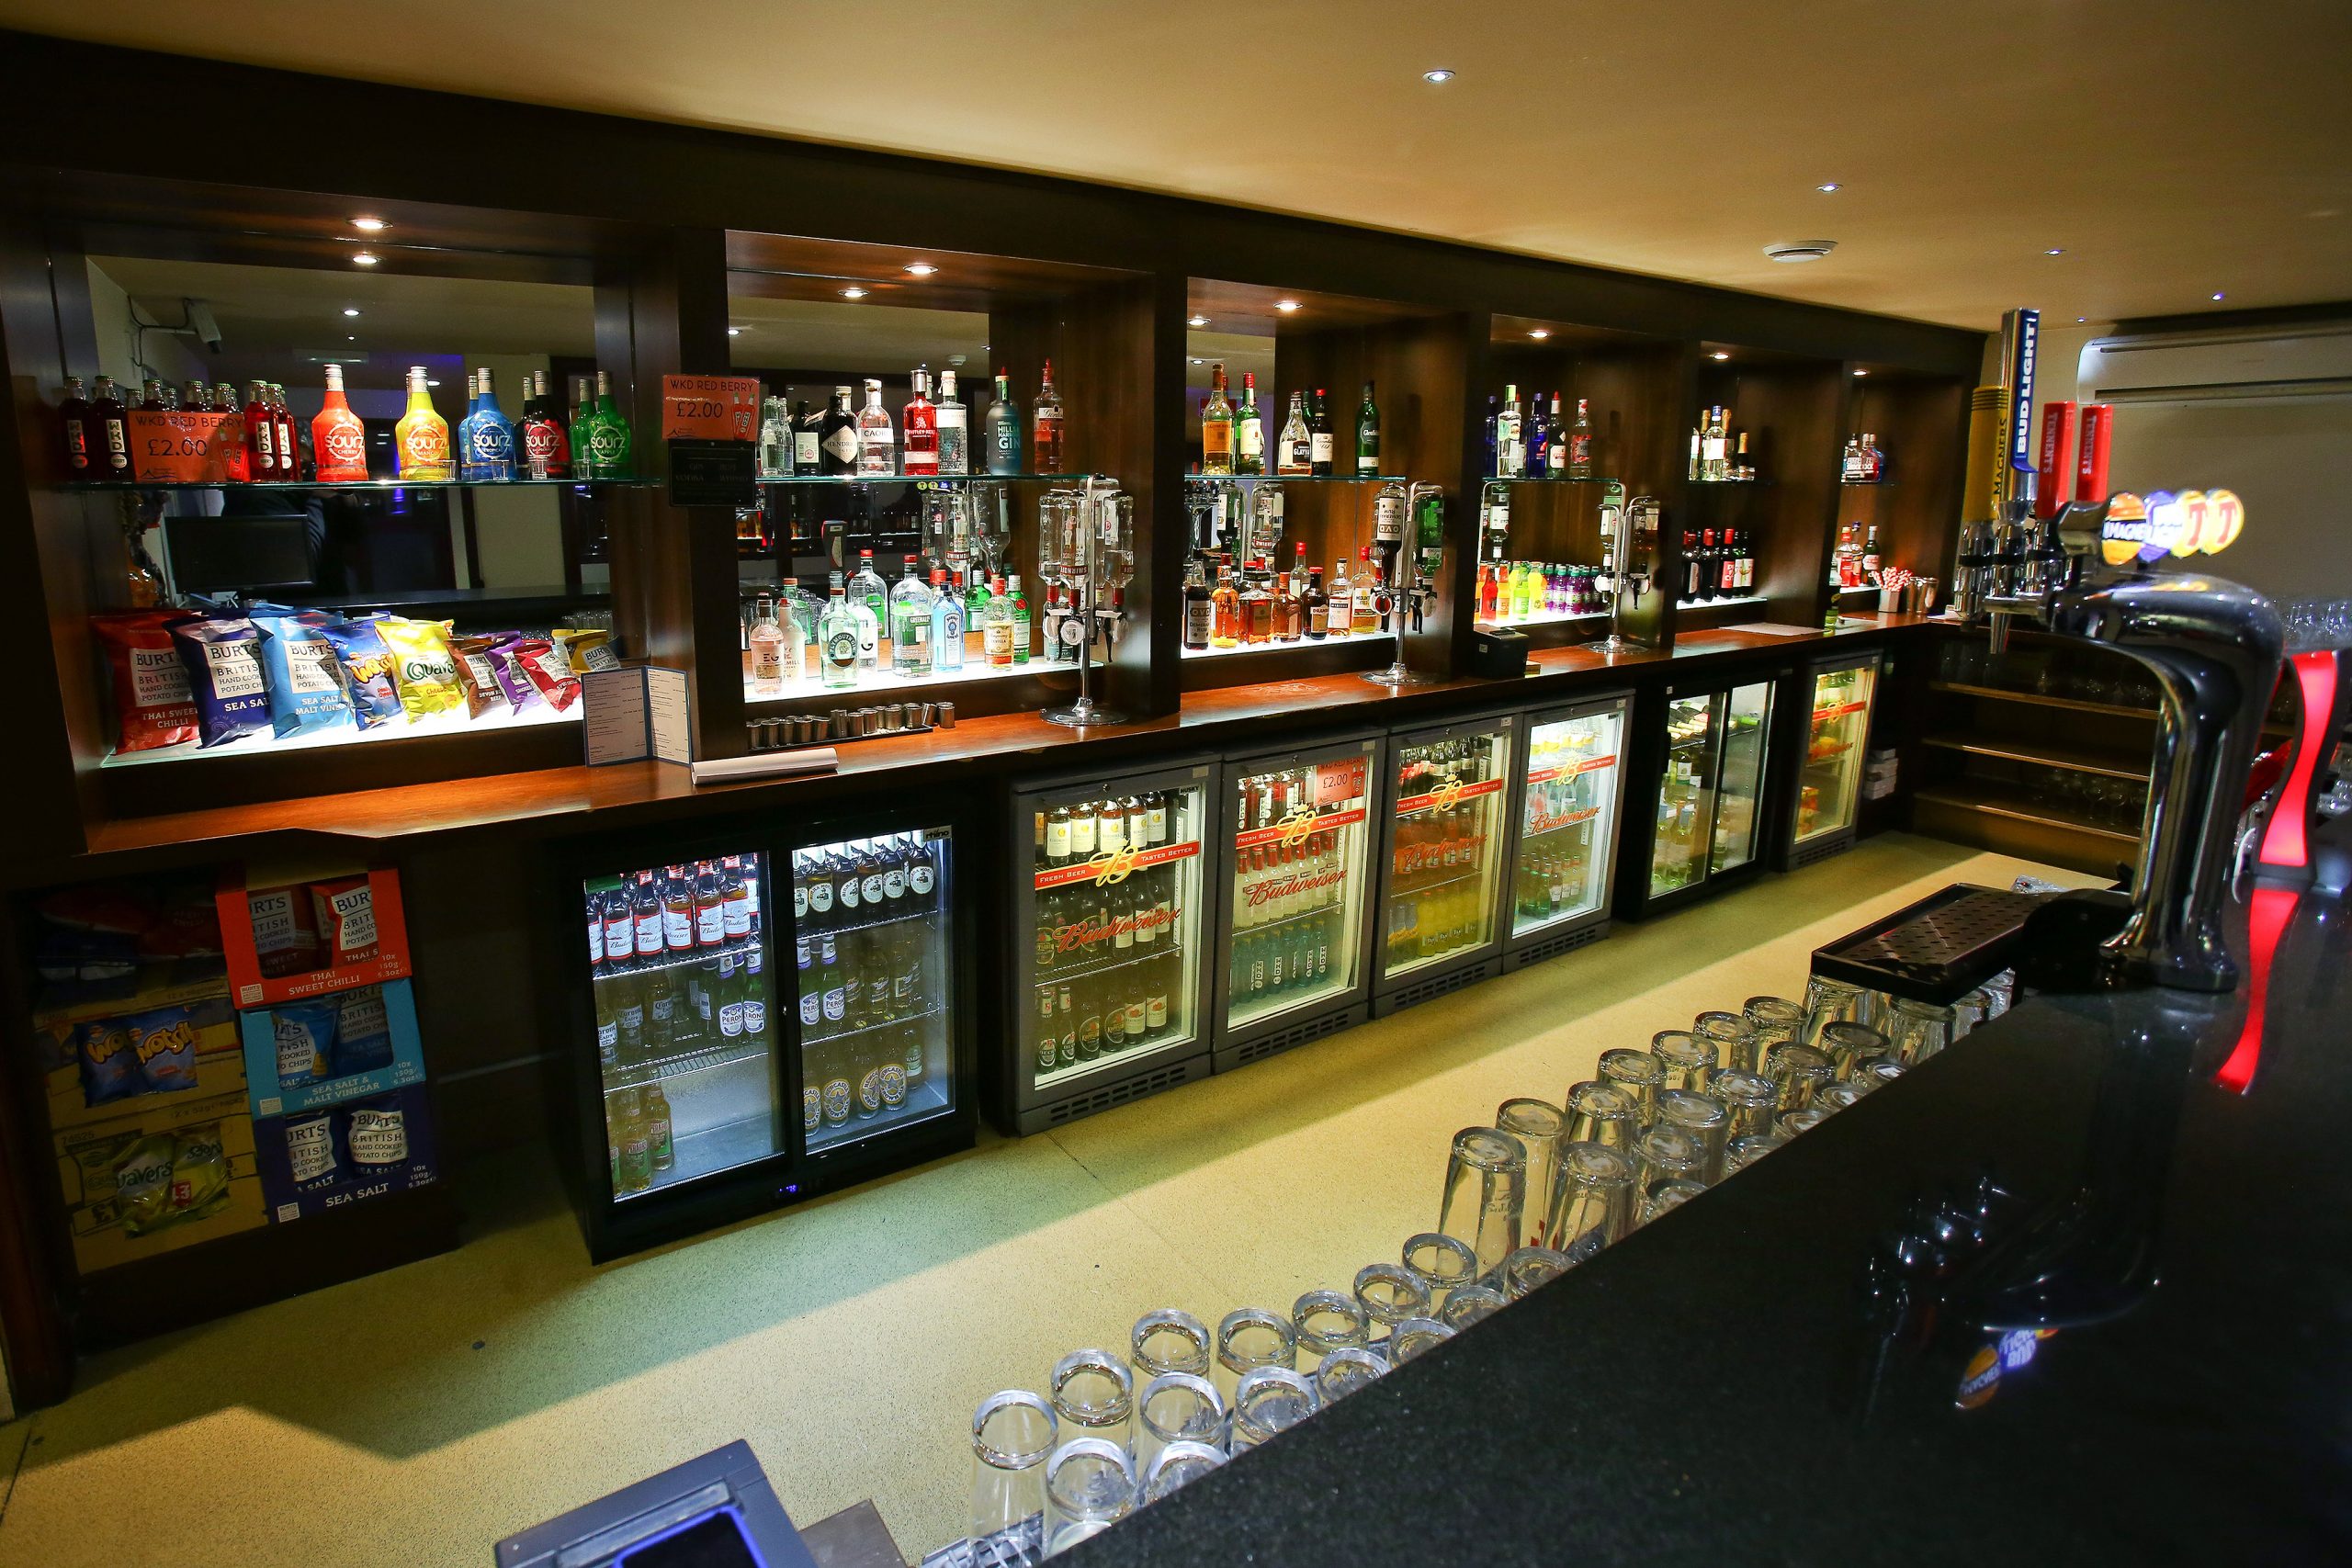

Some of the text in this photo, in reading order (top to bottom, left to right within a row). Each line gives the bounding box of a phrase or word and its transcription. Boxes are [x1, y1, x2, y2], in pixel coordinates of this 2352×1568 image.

[671, 379, 753, 392] WKD RED BERRY
[2017, 322, 2037, 454] BUD LIGHT
[676, 402, 723, 418] £2.00
[135, 416, 242, 428] WKD RED BERRY
[257, 423, 269, 451] WKD
[999, 437, 1021, 449] GIN
[148, 438, 207, 457] £2.00
[1993, 418, 2007, 495] MAGNERS
[2189, 502, 2208, 547] T
[2219, 502, 2236, 544] T
[210, 643, 262, 660] BURTS
[289, 644, 334, 656] BURTS
[219, 677, 242, 685] HAND
[220, 684, 250, 694] POTATO
[301, 694, 339, 705] SEA SALT
[142, 706, 198, 720] THAI SWEET
[224, 702, 247, 712] SEA
[295, 706, 319, 716] MALT
[157, 717, 188, 728] CHILLI
[1323, 773, 1348, 789] £2.00
[1317, 818, 1338, 827] TASTES
[1340, 814, 1360, 822] BETTER
[1530, 806, 1600, 835] Budweiser
[926, 829, 949, 839] rhino
[1039, 874, 1064, 884] FRESH
[1067, 869, 1086, 878] BEER
[1141, 852, 1166, 863] TASTES
[1168, 847, 1193, 856] BETTER
[1243, 869, 1348, 908] Budweiser
[345, 927, 366, 938] HAND
[1052, 908, 1182, 953] Budweiser
[345, 931, 375, 945] POTATO
[345, 952, 369, 963] THAI
[311, 970, 336, 981] THAI
[288, 975, 360, 996] SWEET CHILLI
[288, 1058, 311, 1068] CHIPS
[312, 1077, 370, 1095] SEA SALT &
[304, 1082, 379, 1106] MALT VINEGAR
[357, 1113, 401, 1127] BURTS
[352, 1133, 402, 1144] BRITISH
[307, 1175, 335, 1191] SALT
[325, 1182, 390, 1207] SEA SALT
